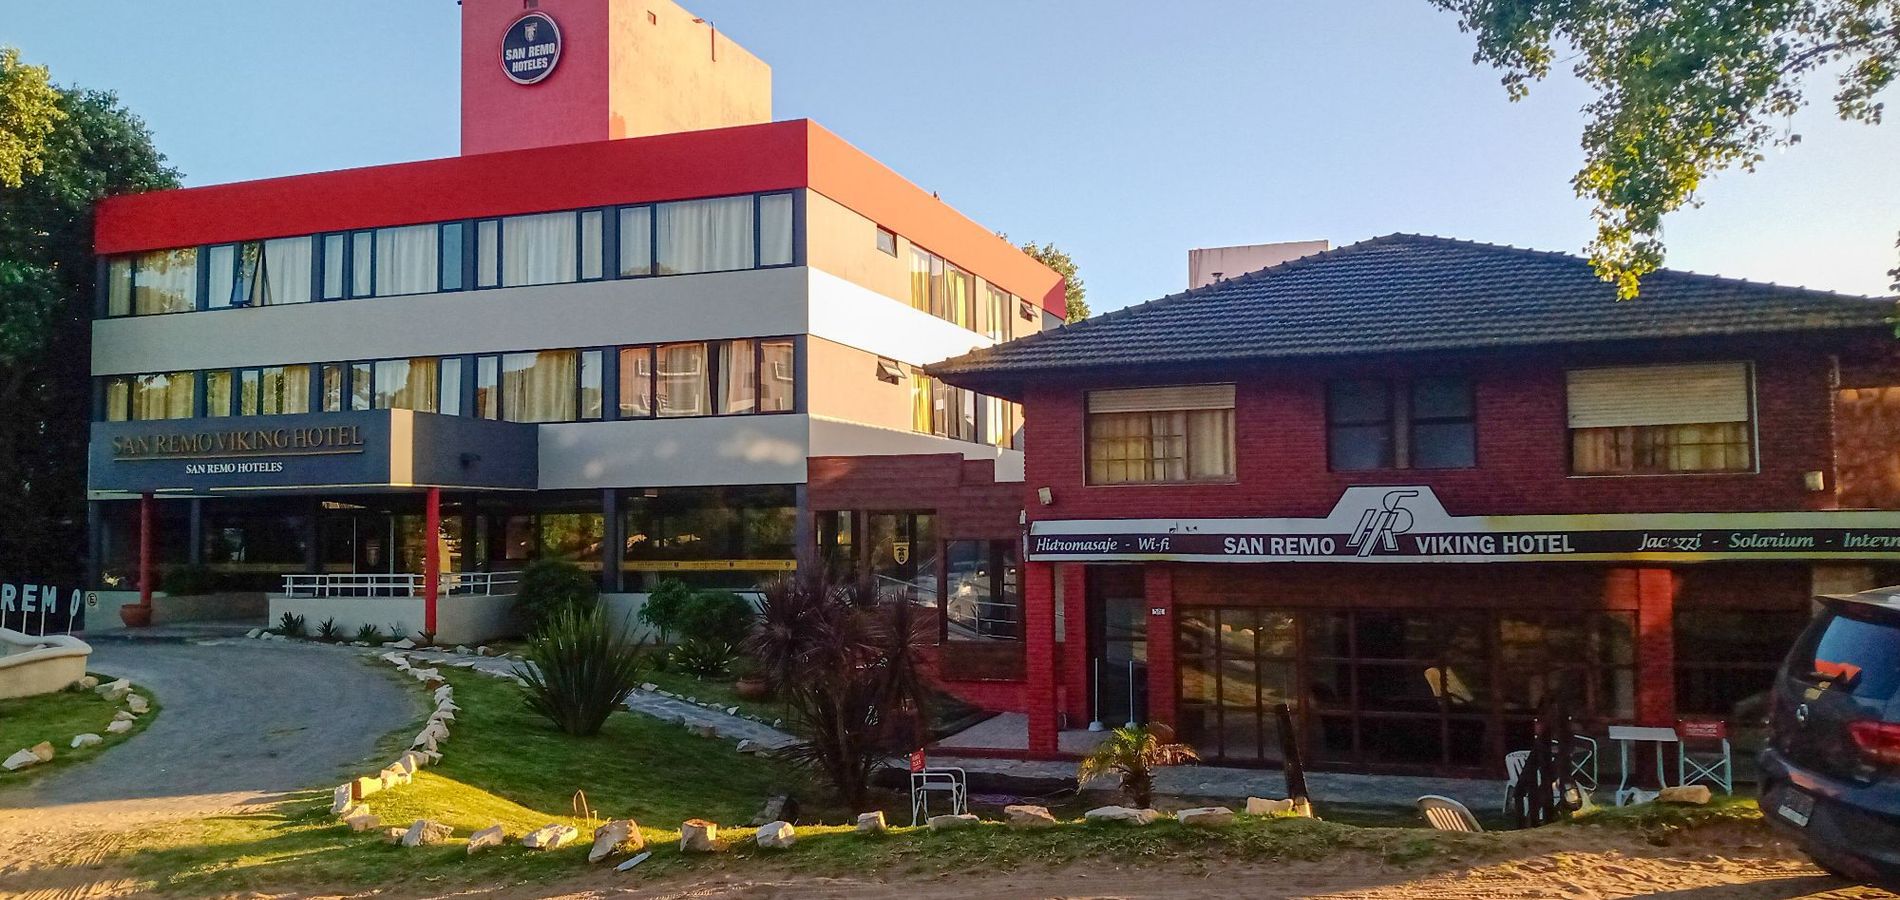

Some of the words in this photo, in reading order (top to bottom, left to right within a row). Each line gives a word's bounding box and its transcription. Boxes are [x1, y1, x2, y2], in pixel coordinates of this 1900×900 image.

[505, 47, 526, 60] SAN
[528, 43, 555, 57] REMO
[512, 57, 548, 72] HOTELES
[111, 433, 152, 456] SAN
[155, 431, 212, 453] REMO
[216, 428, 290, 451] VIKING
[293, 425, 364, 447] HOTEL
[185, 463, 206, 475] SAN
[207, 463, 235, 474] REMO
[237, 461, 283, 473] HOTELES
[1036, 537, 1118, 553] Hidromasaje
[1138, 537, 1170, 552] Wi-fi
[1224, 537, 1264, 555] SAN
[1270, 537, 1336, 555] REMO
[1415, 536, 1495, 554] VIKING
[1503, 534, 1575, 553] HOTEL
[1728, 532, 1815, 548] Solarium
